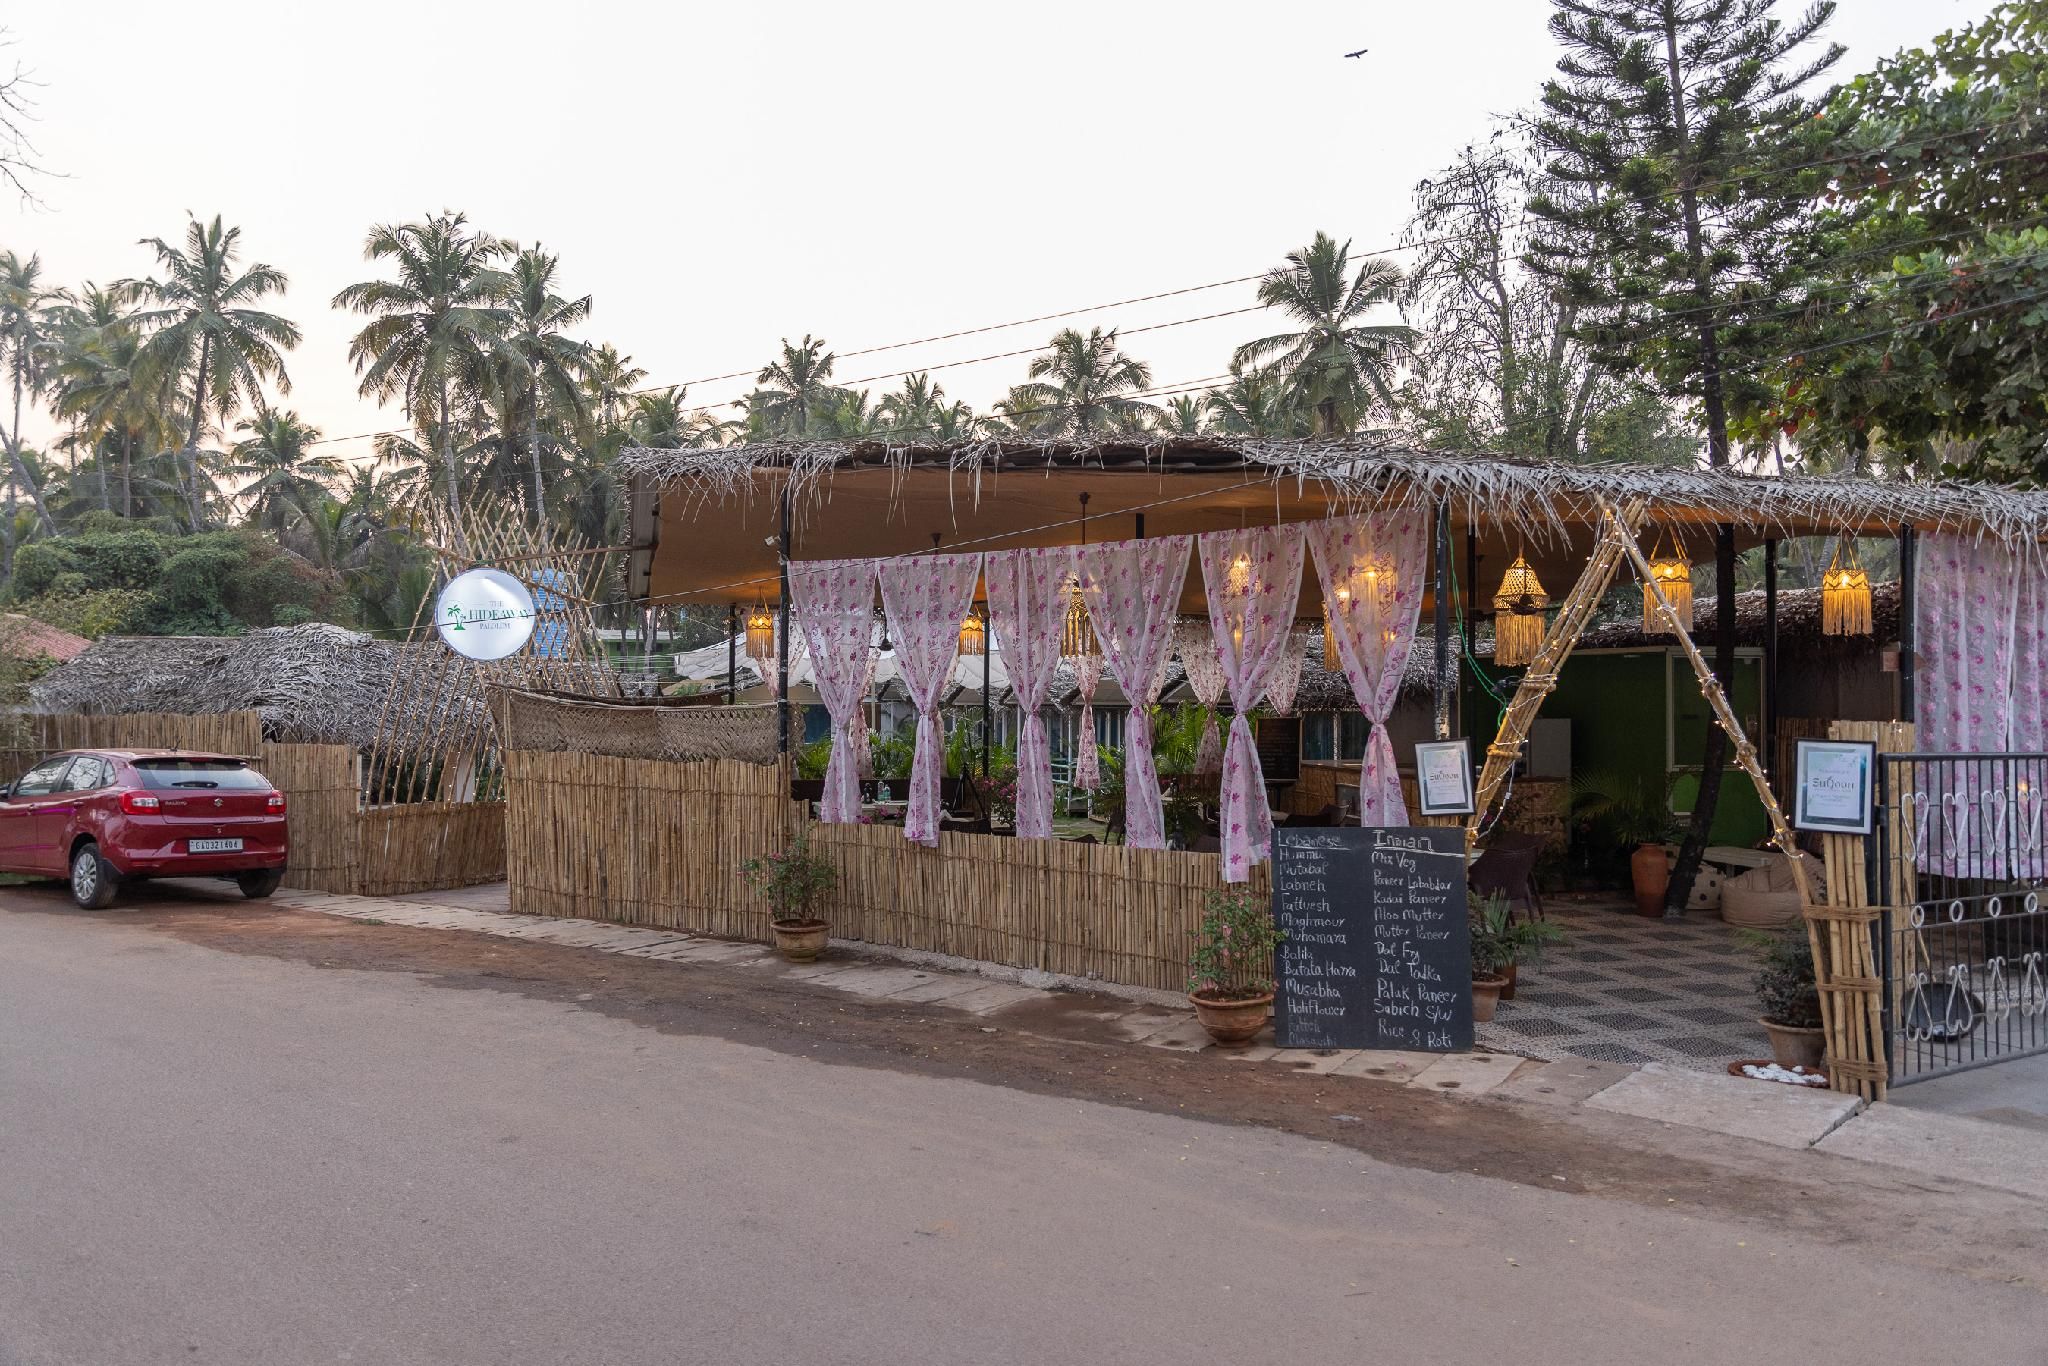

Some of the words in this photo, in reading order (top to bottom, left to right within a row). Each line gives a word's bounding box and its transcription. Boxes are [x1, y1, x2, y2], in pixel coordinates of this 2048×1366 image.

[469, 609, 531, 619] HIDEAWAY
[1277, 830, 1342, 847] Lebanese
[1396, 852, 1416, 873] Veg
[1279, 877, 1326, 892] Labneh
[1408, 889, 1447, 904] Paneer
[1374, 906, 1399, 921] Aloo
[1373, 941, 1397, 957] Dal
[1283, 960, 1324, 977] Batata
[1375, 957, 1401, 974] Dal
[1417, 982, 1457, 1003] Paneer
[1378, 1018, 1406, 1037] Rice
[1427, 1028, 1452, 1048] Roti
